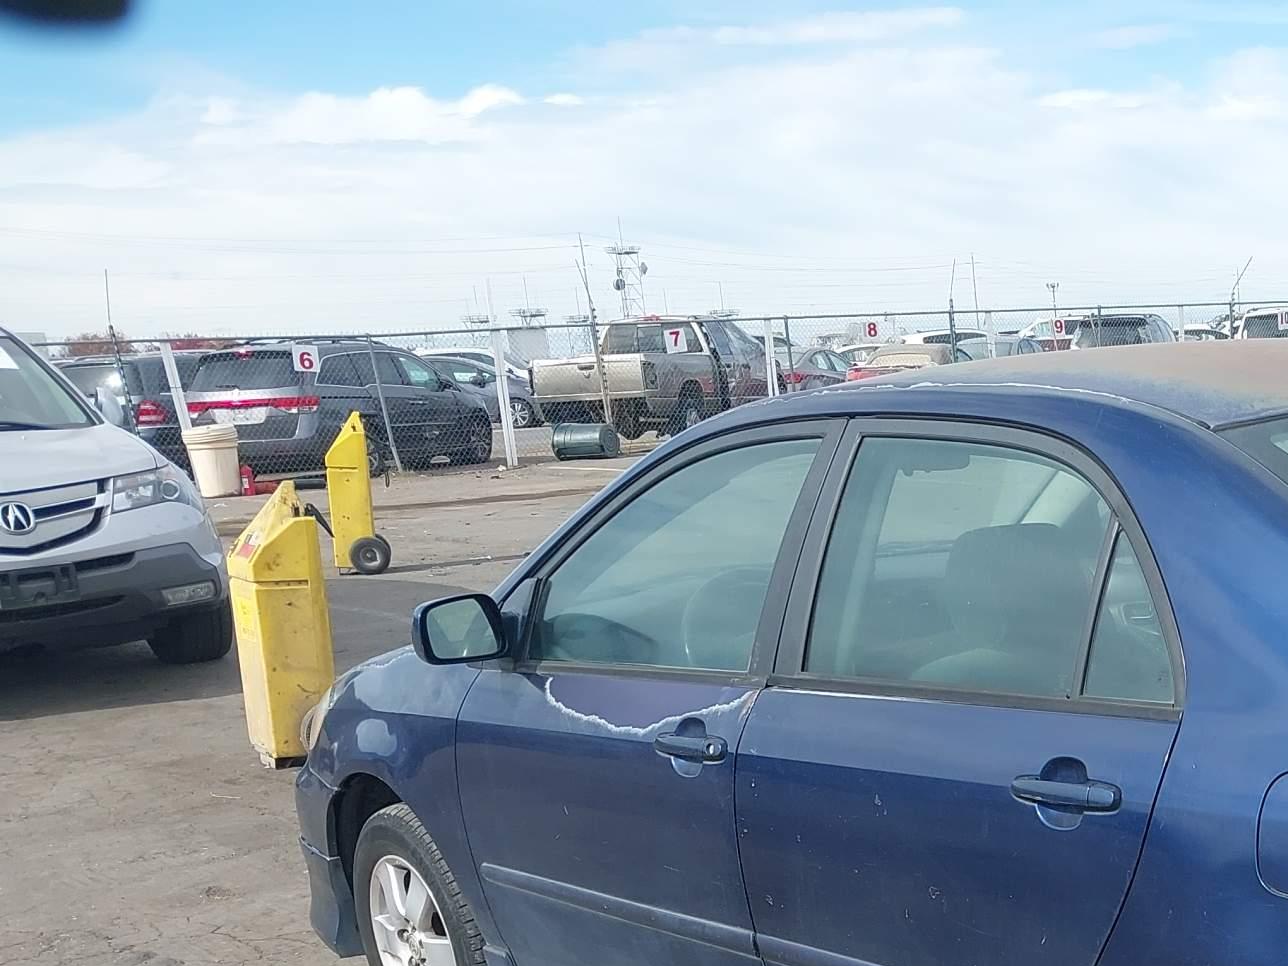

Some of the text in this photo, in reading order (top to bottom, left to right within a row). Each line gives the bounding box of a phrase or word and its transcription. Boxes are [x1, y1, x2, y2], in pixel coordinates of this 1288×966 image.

[867, 322, 878, 338] 8
[1054, 319, 1064, 334] 9
[669, 330, 680, 347] 7
[299, 351, 314, 370] 6
